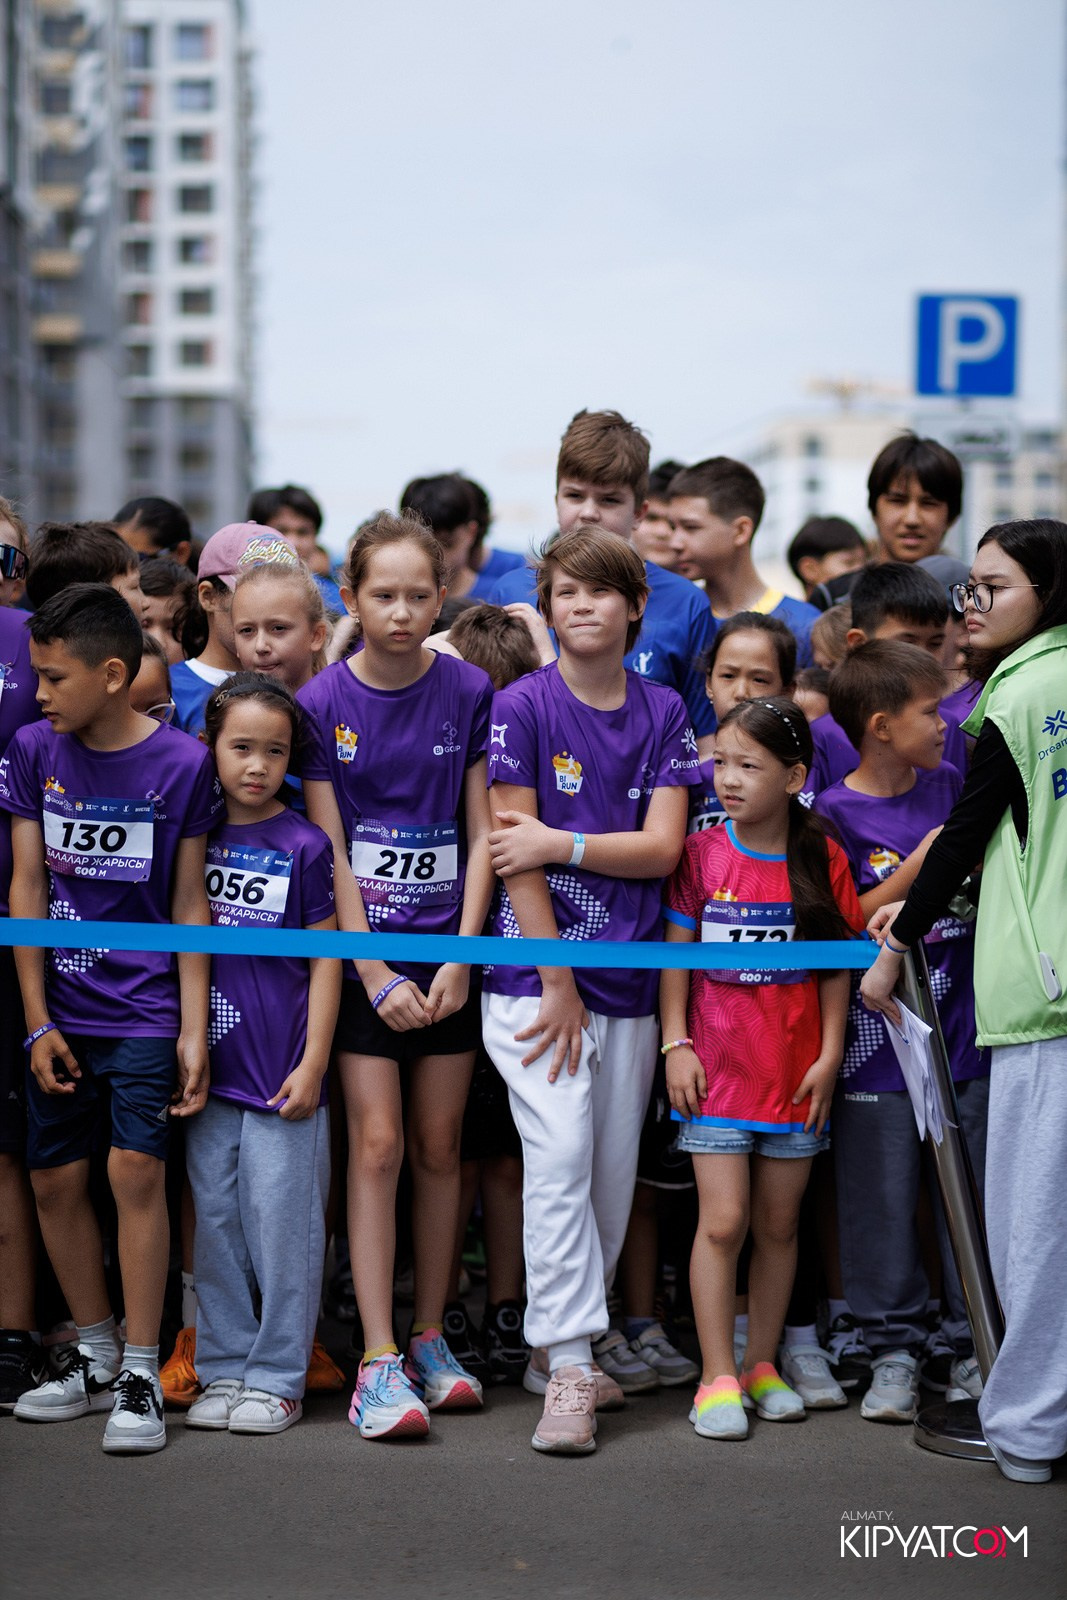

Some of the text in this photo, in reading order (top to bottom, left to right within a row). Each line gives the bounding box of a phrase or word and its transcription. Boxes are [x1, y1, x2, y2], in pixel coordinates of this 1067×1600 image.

[937, 300, 1006, 391] P
[501, 754, 520, 769] City
[561, 782, 578, 790] RUN
[62, 822, 127, 853] 130
[46, 848, 146, 869] БАЛАЛАР ЖАРЫСЫ
[373, 849, 437, 880] 218
[74, 866, 96, 876] 600
[205, 869, 270, 905] 056
[404, 882, 453, 894] ЖАРЫСЫ
[388, 894, 410, 904] 600
[218, 915, 231, 925] 600
[229, 906, 279, 923] ЖАРЫСЫ
[941, 927, 960, 938] 600
[739, 972, 761, 982] 600
